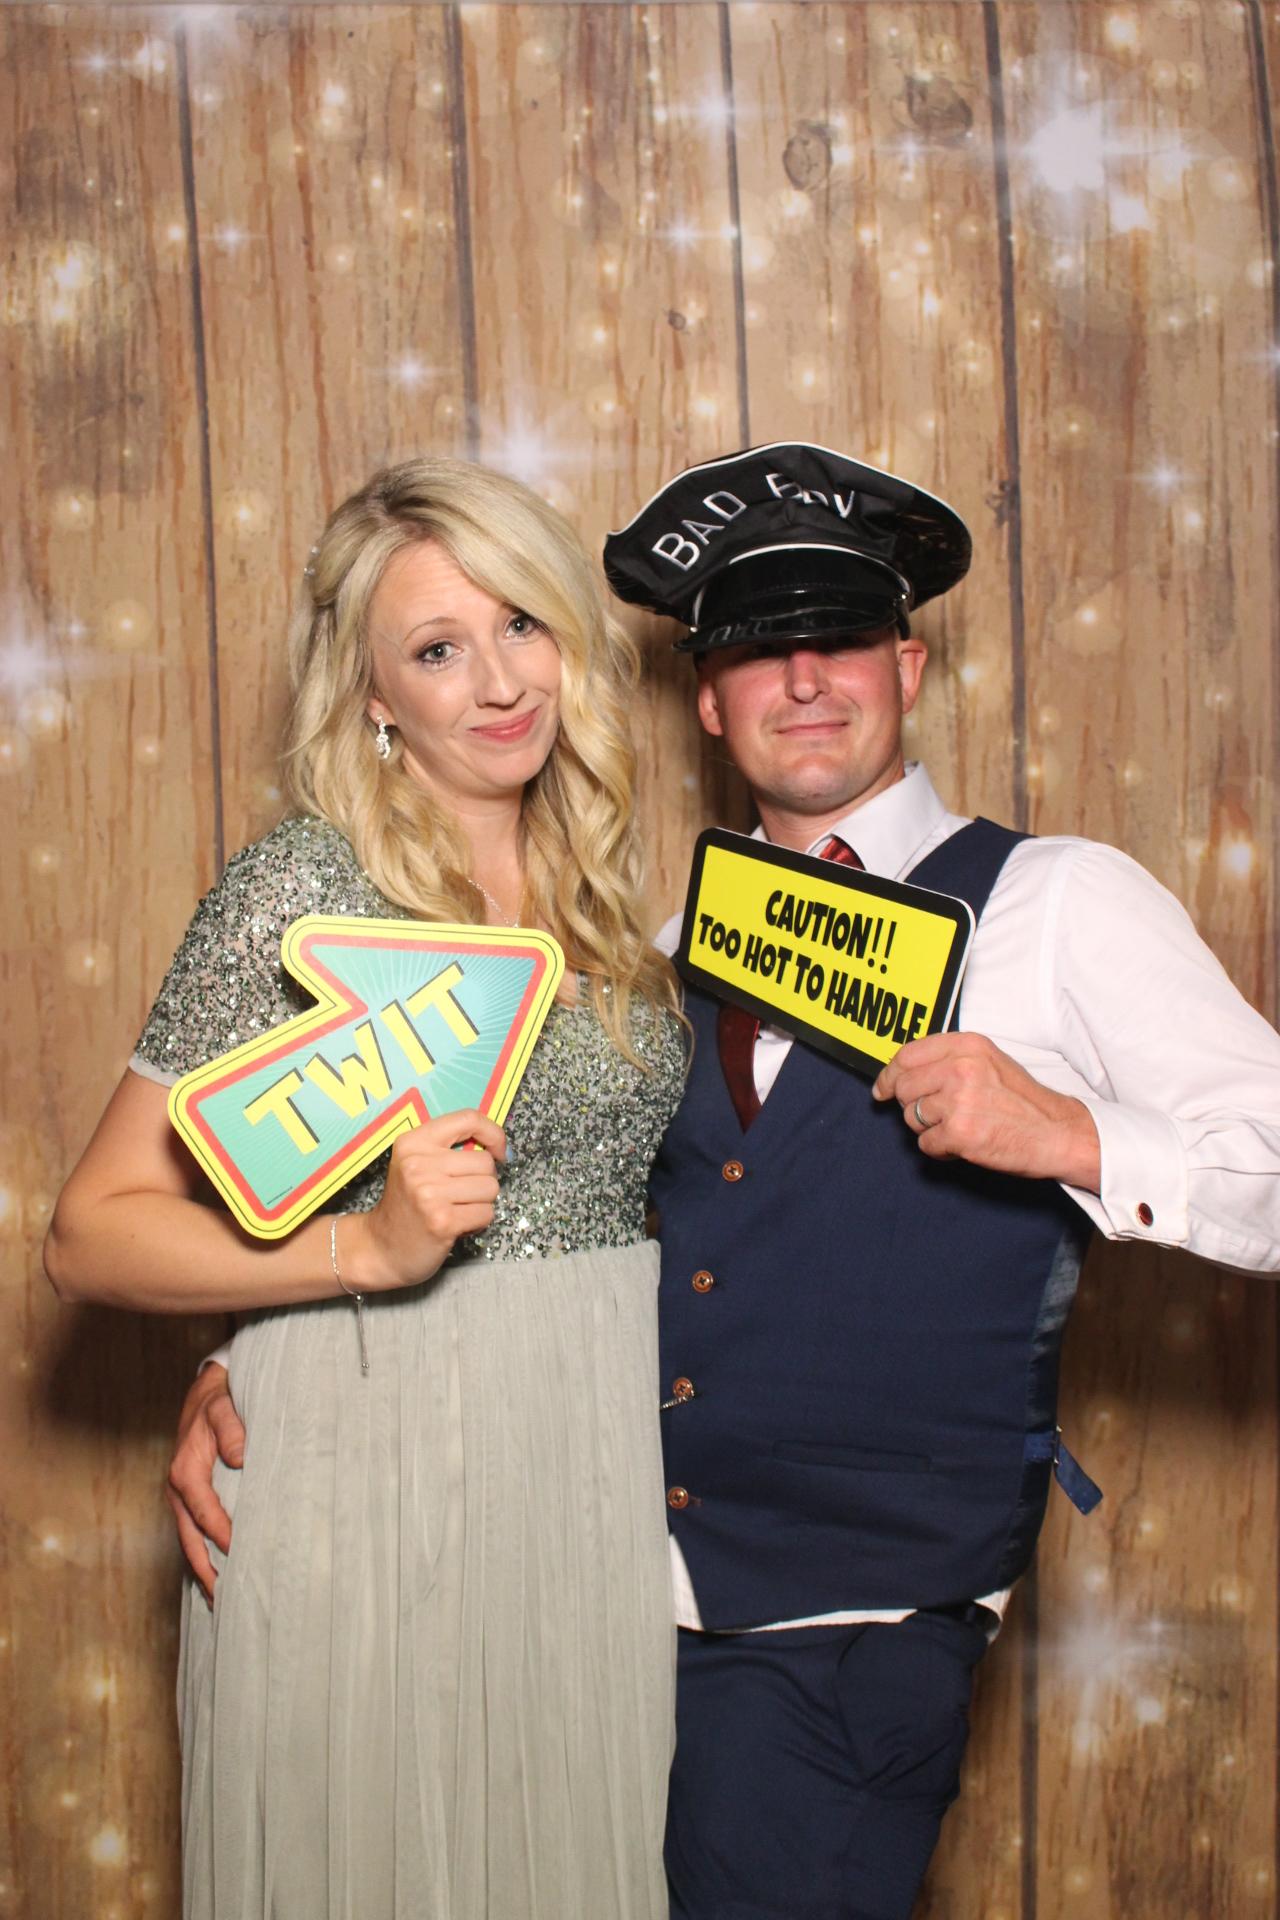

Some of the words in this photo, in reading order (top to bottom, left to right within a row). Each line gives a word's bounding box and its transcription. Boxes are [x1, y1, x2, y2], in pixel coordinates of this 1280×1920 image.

[651, 490, 748, 572] BAD
[698, 913, 741, 960] TOO
[742, 934, 792, 985] HOT
[793, 953, 825, 1001] TO
[824, 969, 928, 1045] HANDLE
[765, 889, 897, 975] CAUTION!!
[243, 960, 480, 1156] TWIT
